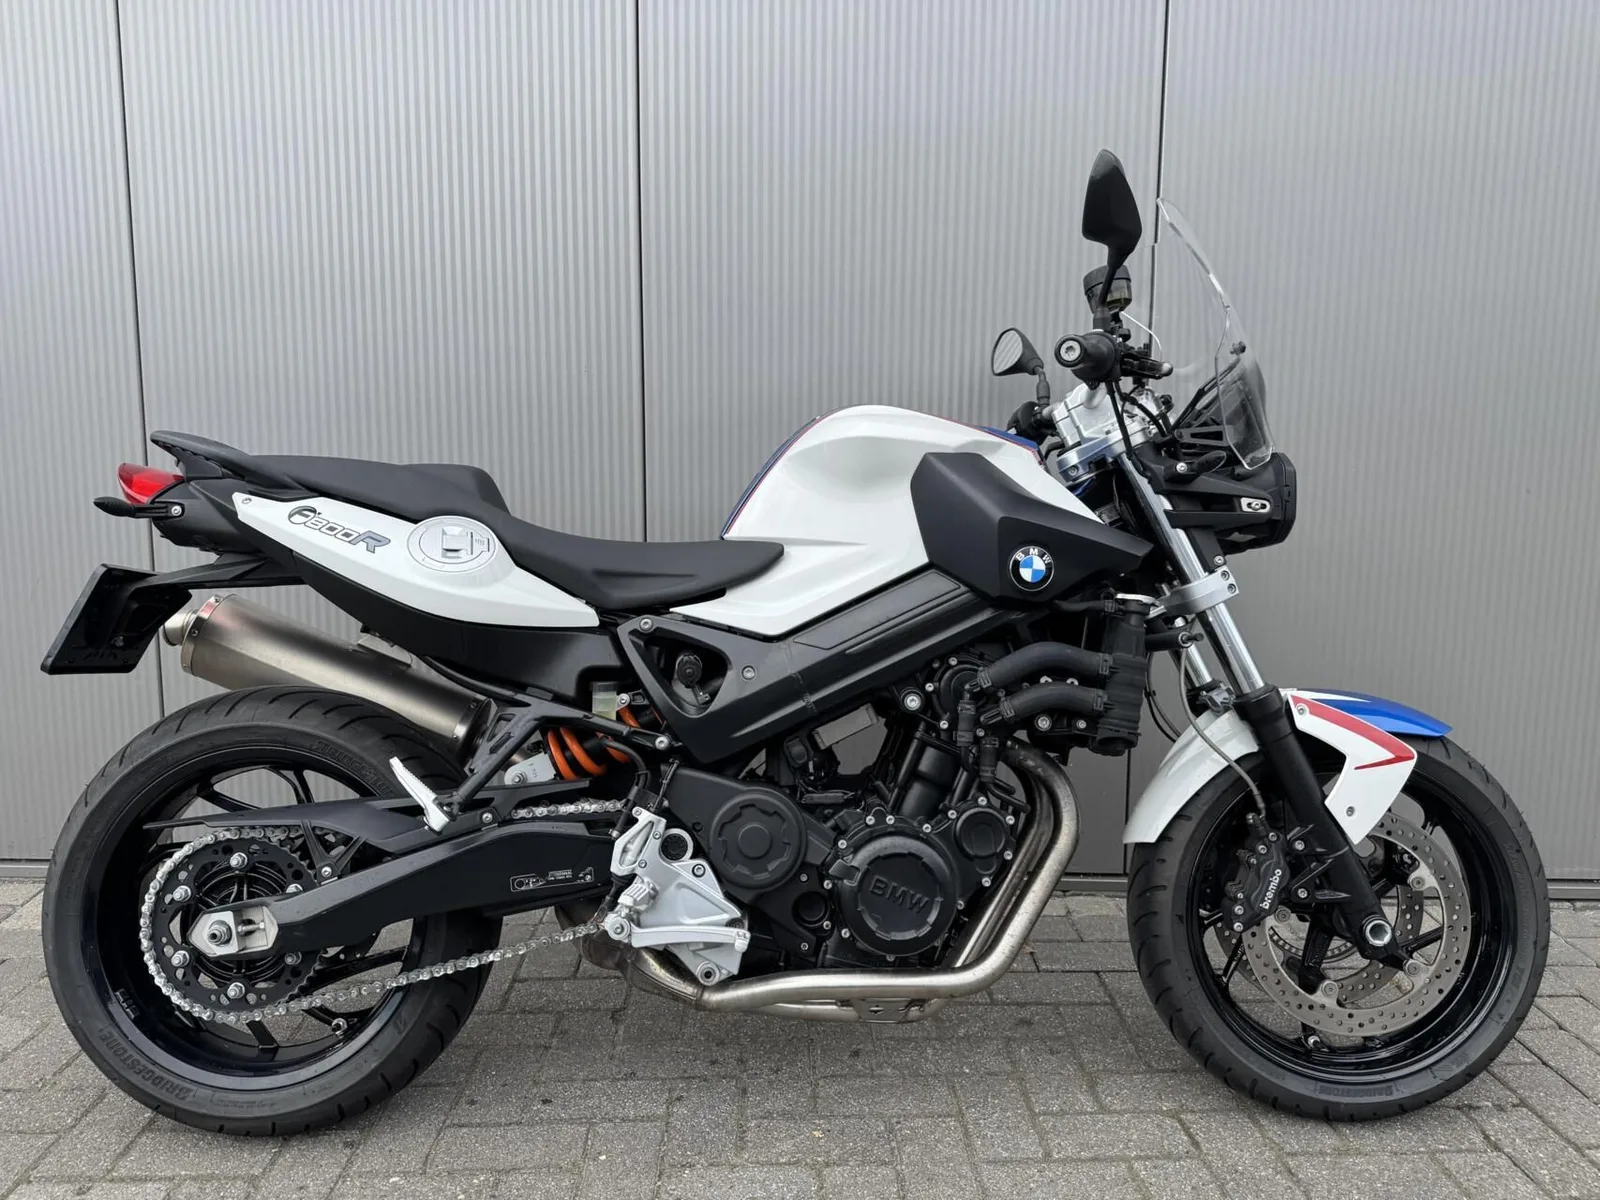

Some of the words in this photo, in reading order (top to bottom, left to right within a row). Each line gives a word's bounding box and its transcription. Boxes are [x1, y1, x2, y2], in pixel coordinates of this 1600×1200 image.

[1015, 547, 1051, 564] BMW
[312, 740, 395, 799] BRIDGESTO
[869, 875, 930, 914] BMW
[1260, 868, 1282, 910] brembo
[100, 1031, 193, 1101] BRIDGESTONE
